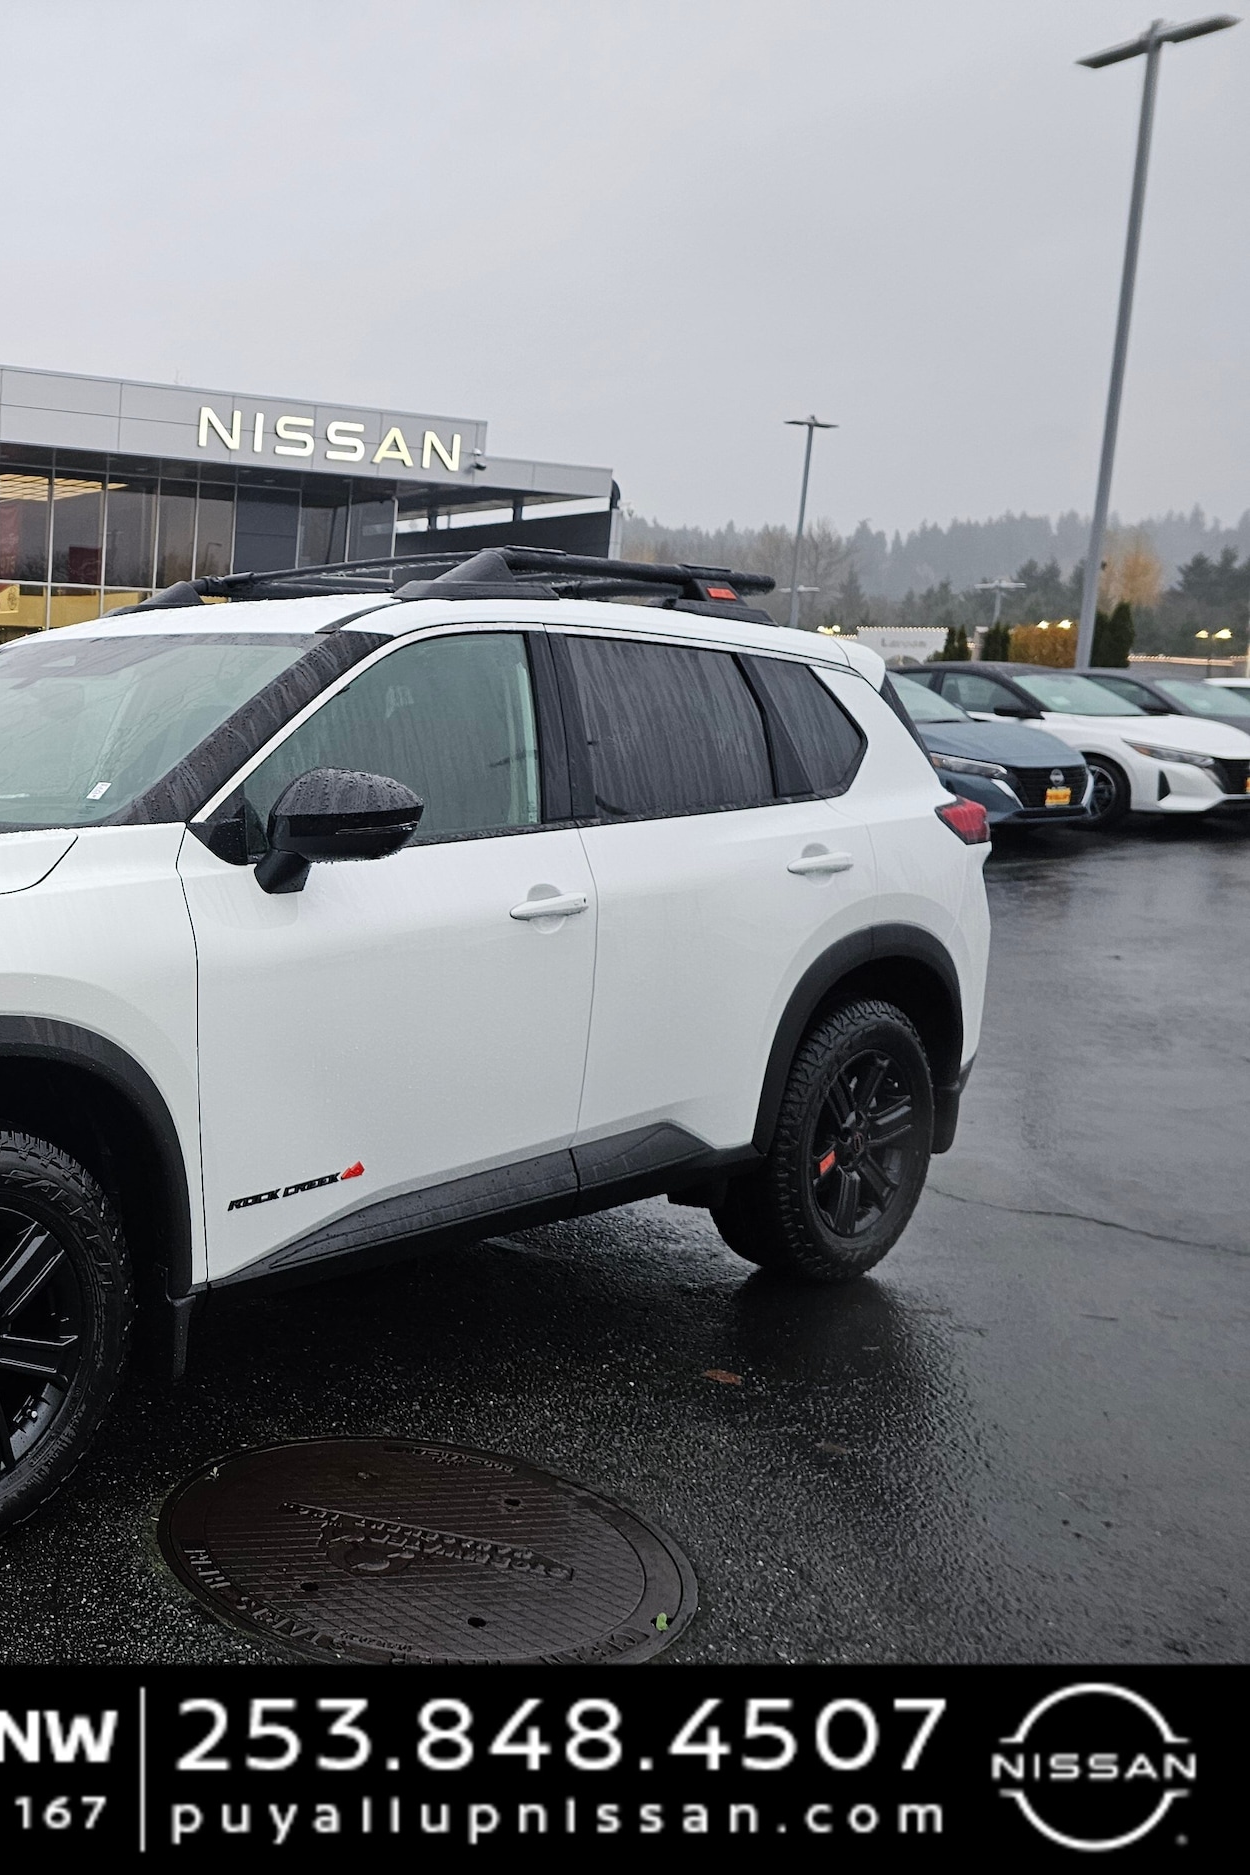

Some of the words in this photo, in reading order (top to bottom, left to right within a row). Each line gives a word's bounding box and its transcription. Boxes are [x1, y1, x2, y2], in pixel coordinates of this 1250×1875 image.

[198, 406, 461, 472] NISSAN
[227, 1188, 281, 1212] ROCK
[282, 1172, 341, 1198] CREEK
